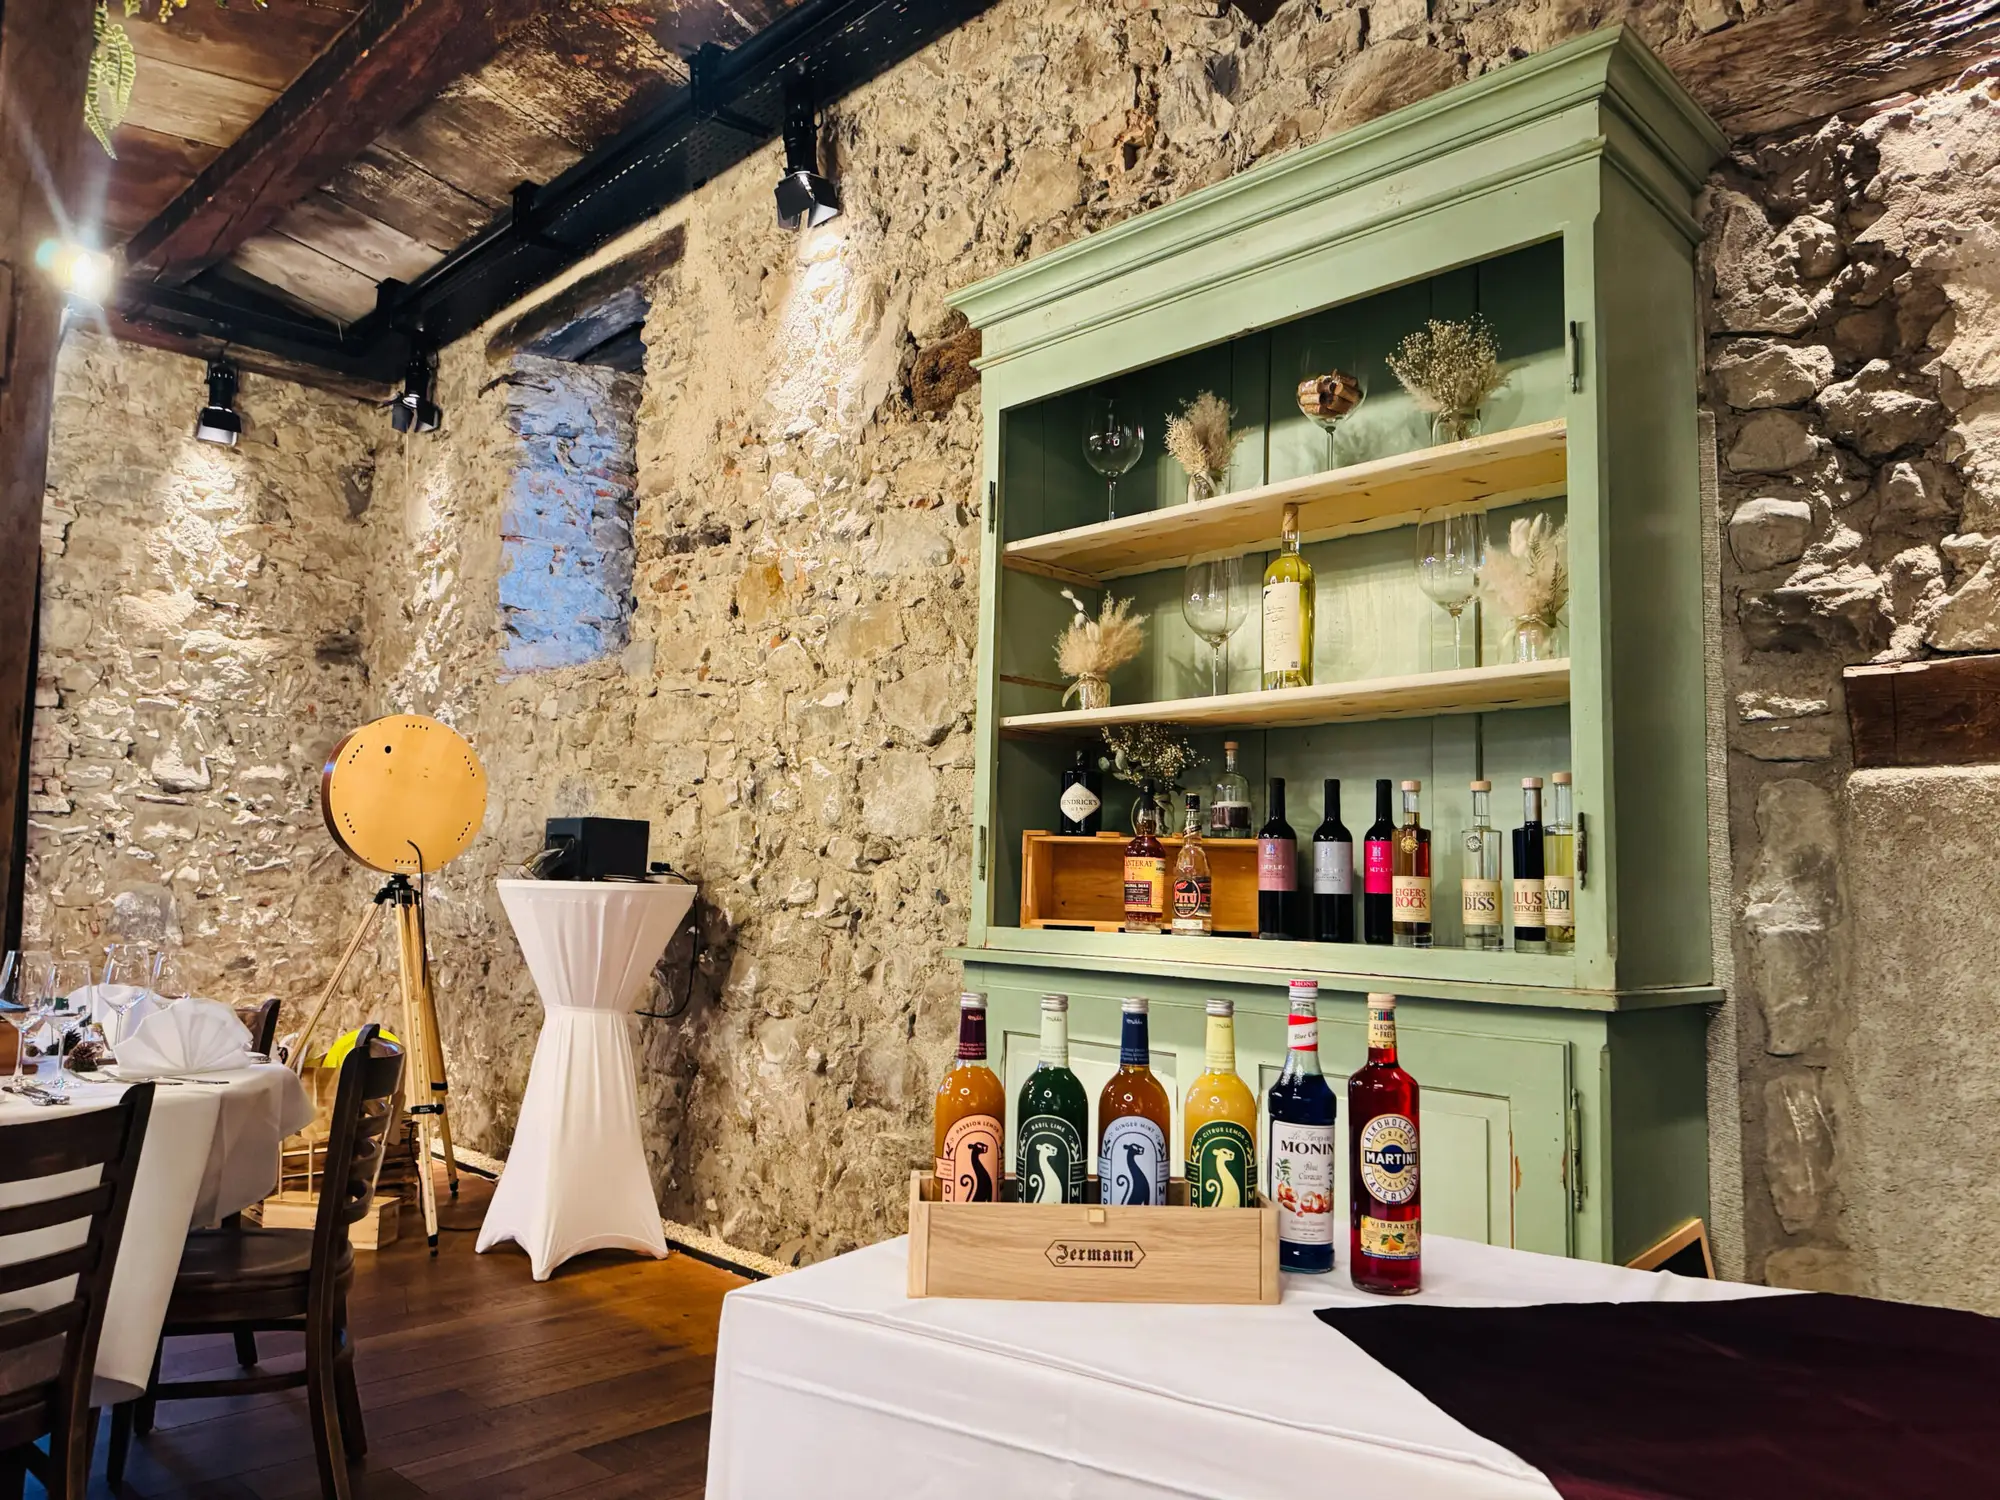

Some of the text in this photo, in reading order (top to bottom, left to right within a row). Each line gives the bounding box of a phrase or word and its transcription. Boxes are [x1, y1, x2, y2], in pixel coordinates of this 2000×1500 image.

[1174, 890, 1197, 904] PITÚ
[1395, 888, 1426, 897] EIGERS
[1545, 886, 1570, 910] NÉPI
[1395, 896, 1426, 908] ROCK
[1464, 897, 1495, 911] BISS
[955, 1120, 982, 1134] PASSION
[1031, 1121, 1066, 1133] BASIL LIME
[1114, 1121, 1155, 1133] GINGER MINT
[1201, 1126, 1245, 1140] CITRUS LEMON
[1364, 1118, 1417, 1145] ALKOHOLFREI
[1375, 1130, 1409, 1145] TORINO
[1281, 1139, 1334, 1156] MONIN
[1366, 1151, 1416, 1165] MARTINI
[1370, 1220, 1415, 1230] VIBRANTE
[1055, 1243, 1134, 1265] Jermann
